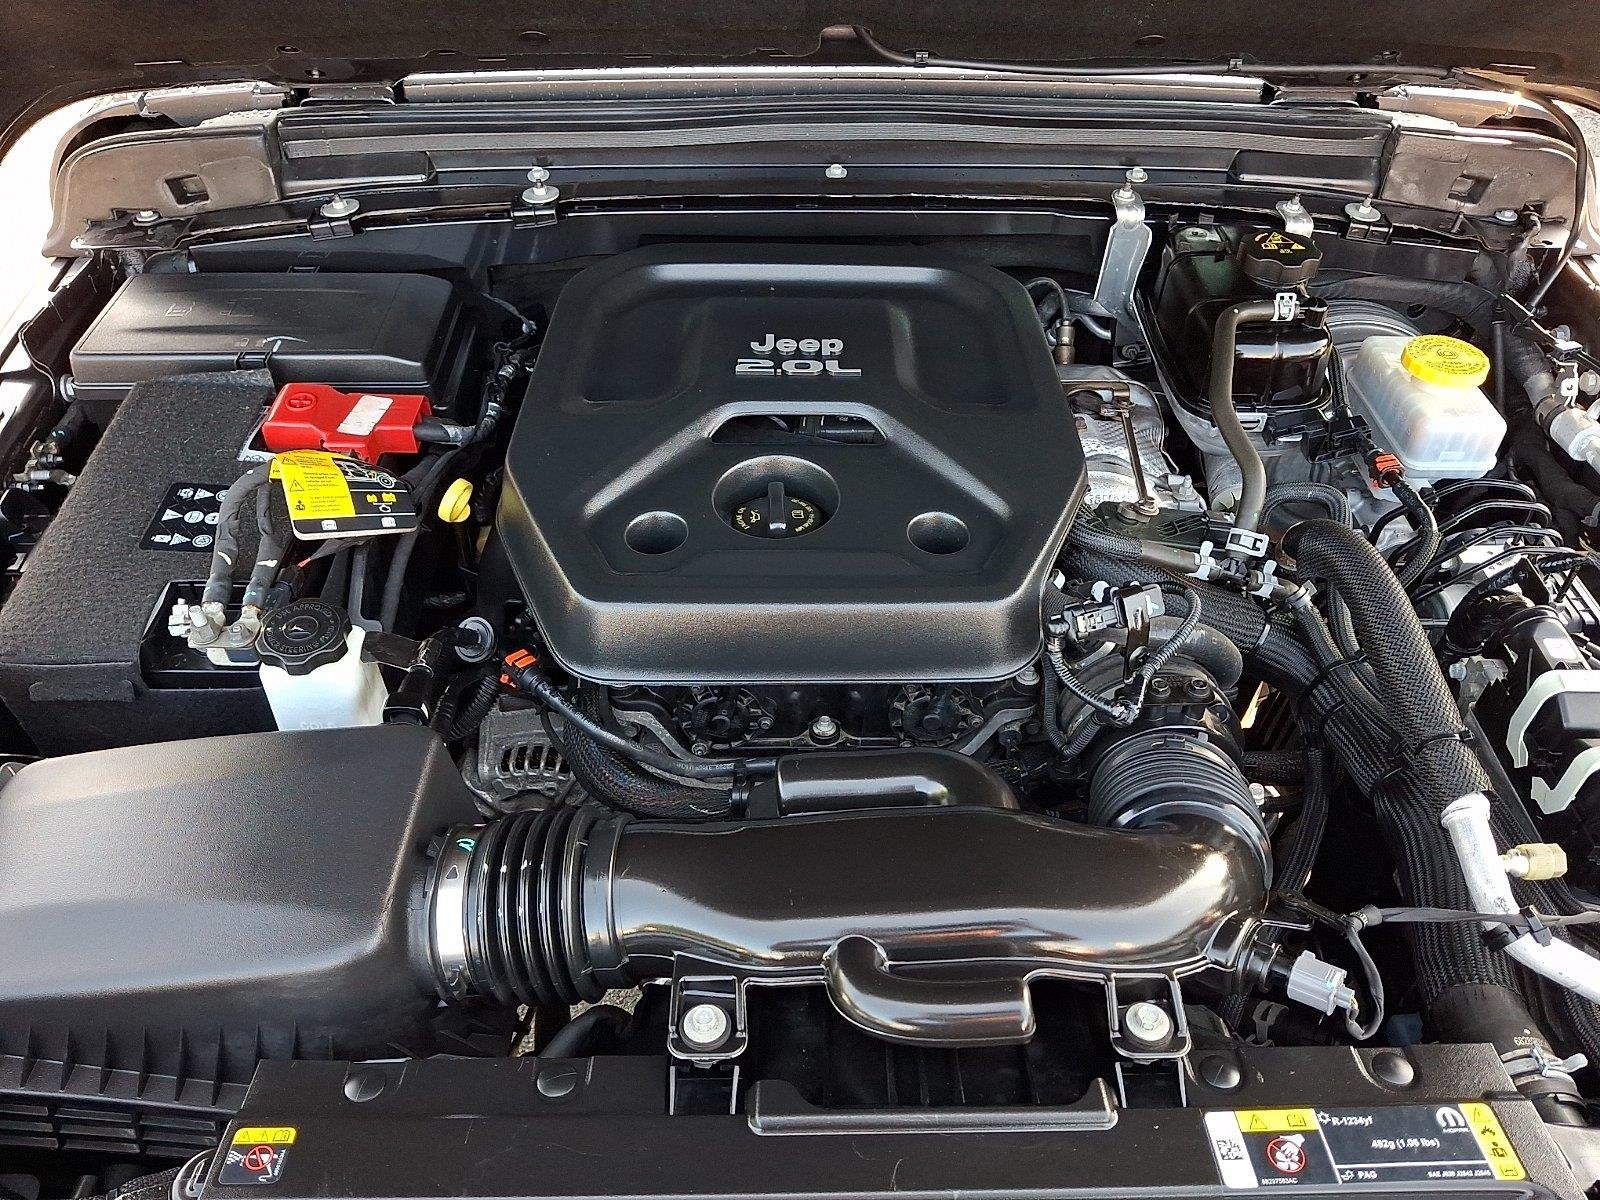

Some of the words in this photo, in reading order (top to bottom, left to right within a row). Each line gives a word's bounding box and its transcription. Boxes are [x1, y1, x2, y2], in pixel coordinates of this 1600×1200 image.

[750, 333, 844, 356] Jeep
[735, 358, 862, 376] 2.0L
[1357, 1170, 1378, 1180] PAG
